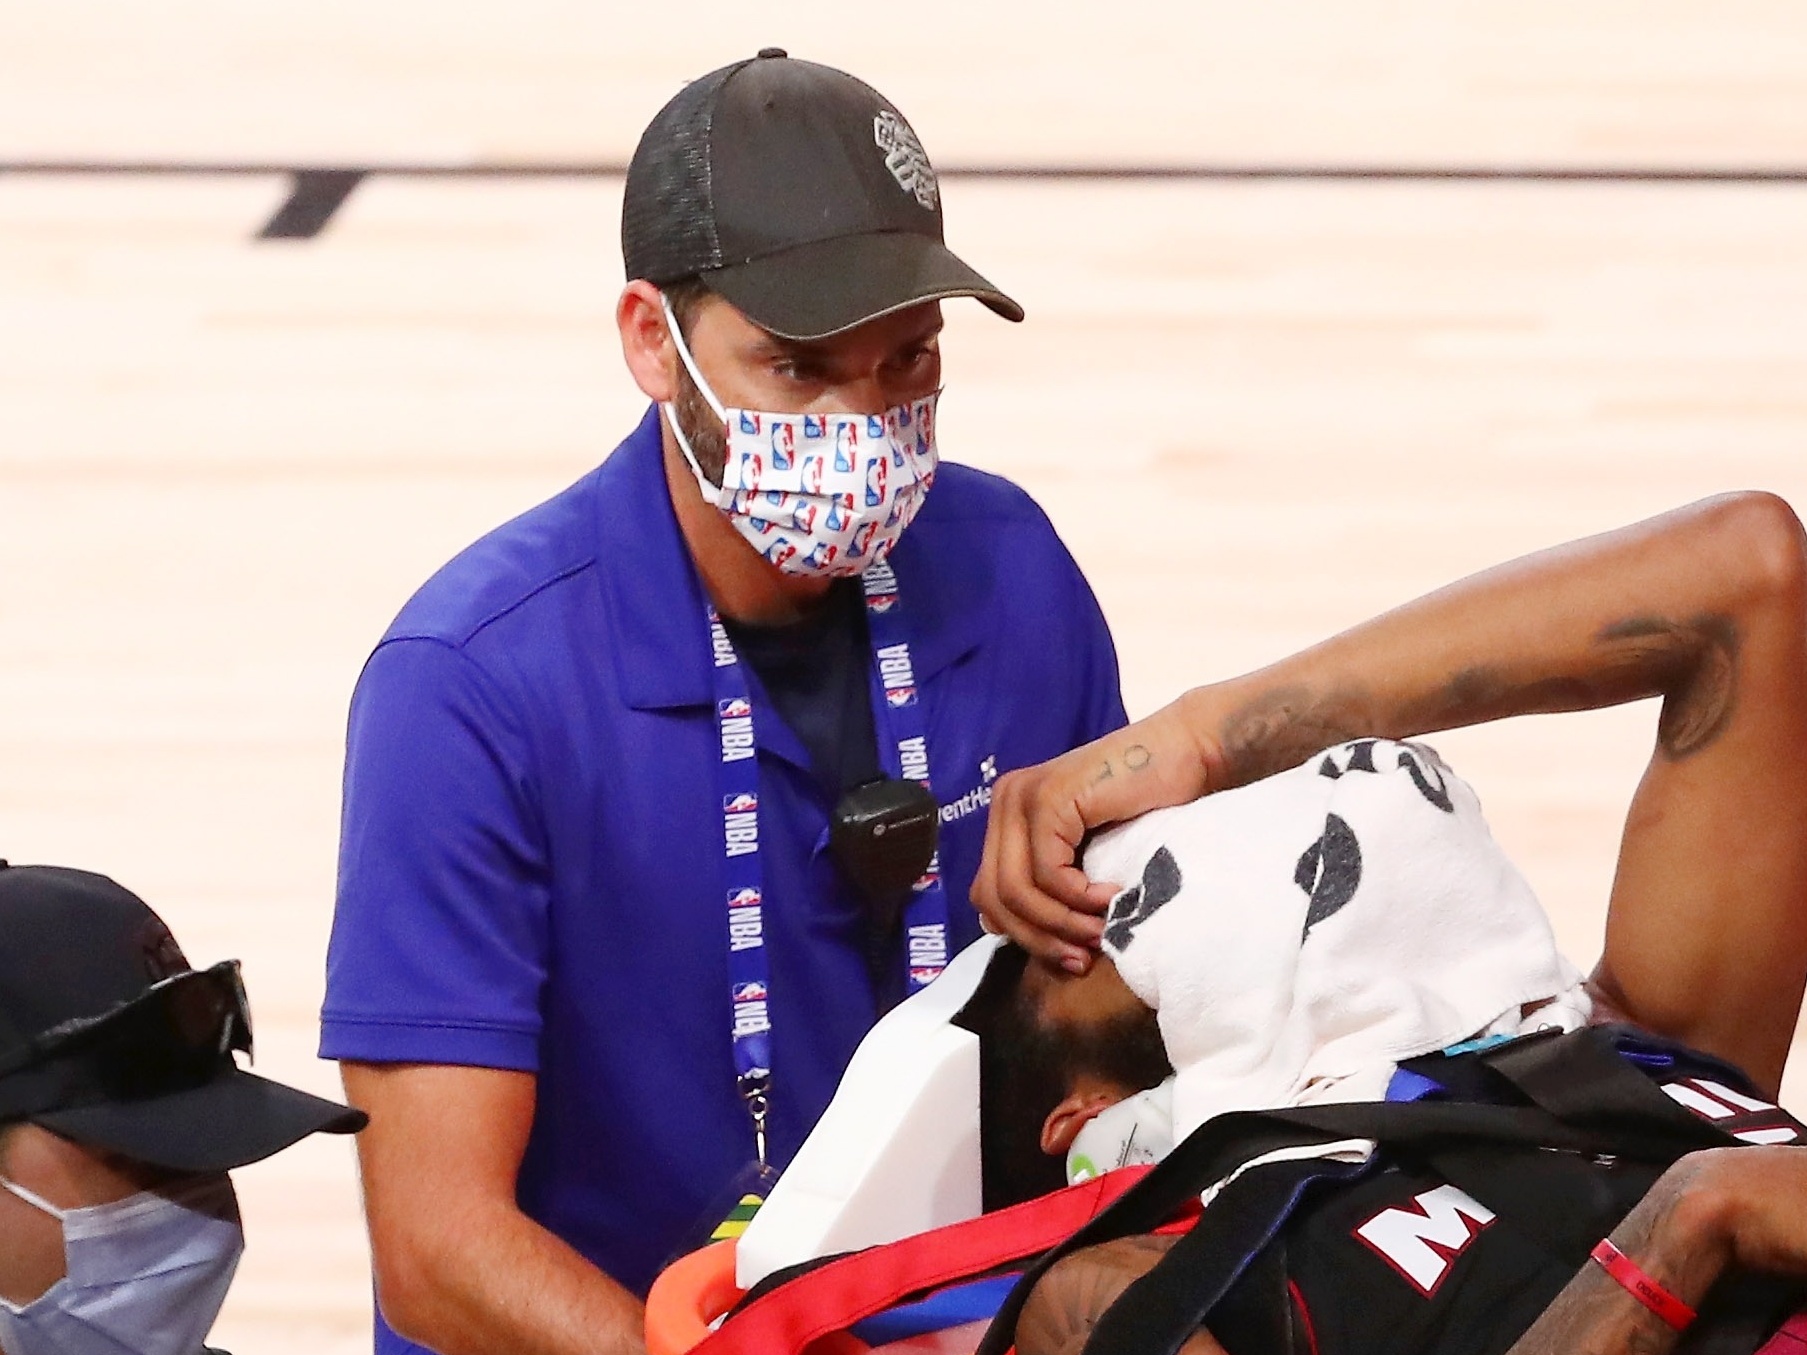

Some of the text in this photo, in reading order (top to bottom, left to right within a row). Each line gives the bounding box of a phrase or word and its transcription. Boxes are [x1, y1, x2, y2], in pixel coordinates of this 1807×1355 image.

[862, 561, 899, 596] NB
[711, 623, 738, 667] NBA
[878, 643, 915, 689] NBA
[720, 717, 756, 763] NBA
[898, 736, 930, 780] NBA
[724, 812, 759, 857] NBA
[728, 906, 764, 952] NBA
[908, 924, 947, 967] NBA
